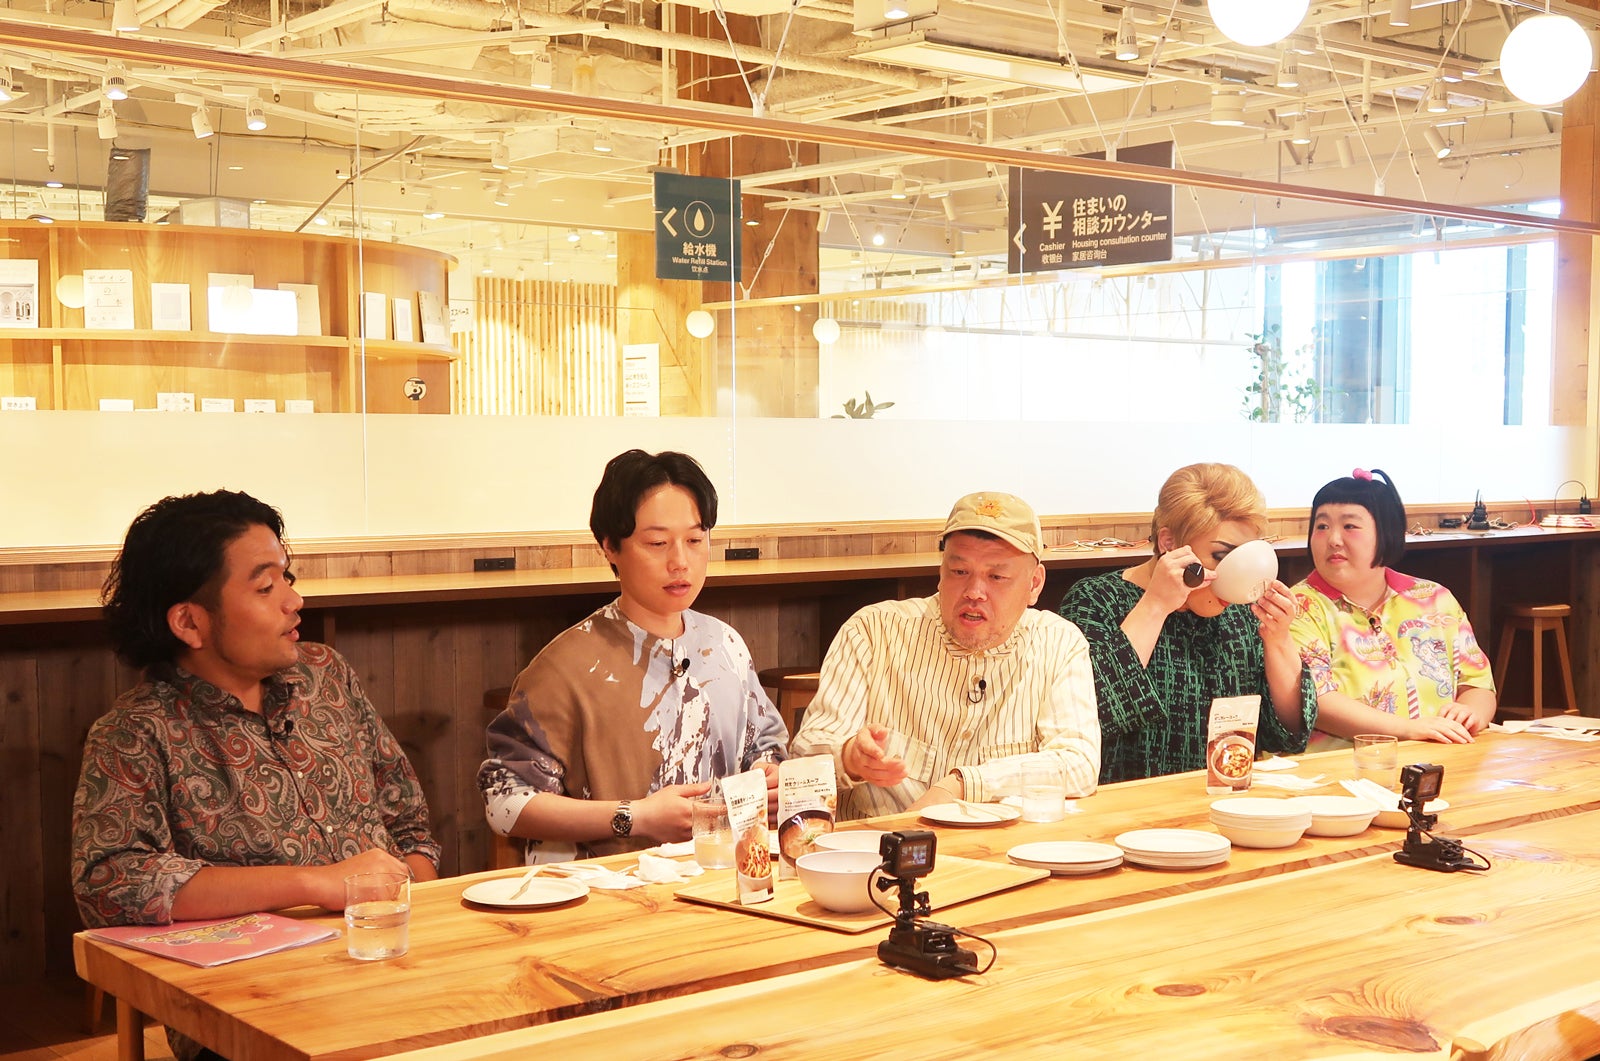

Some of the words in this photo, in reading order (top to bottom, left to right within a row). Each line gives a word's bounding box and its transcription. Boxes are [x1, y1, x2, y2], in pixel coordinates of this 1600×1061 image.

[1072, 194, 1126, 217] 住まいの
[1072, 210, 1168, 236] 相談カウンター
[1039, 242, 1066, 252] Cashier
[1072, 240, 1098, 248] Housing
[1099, 233, 1140, 246] consultation
[1141, 231, 1168, 242] counter
[683, 242, 716, 256] 給水機
